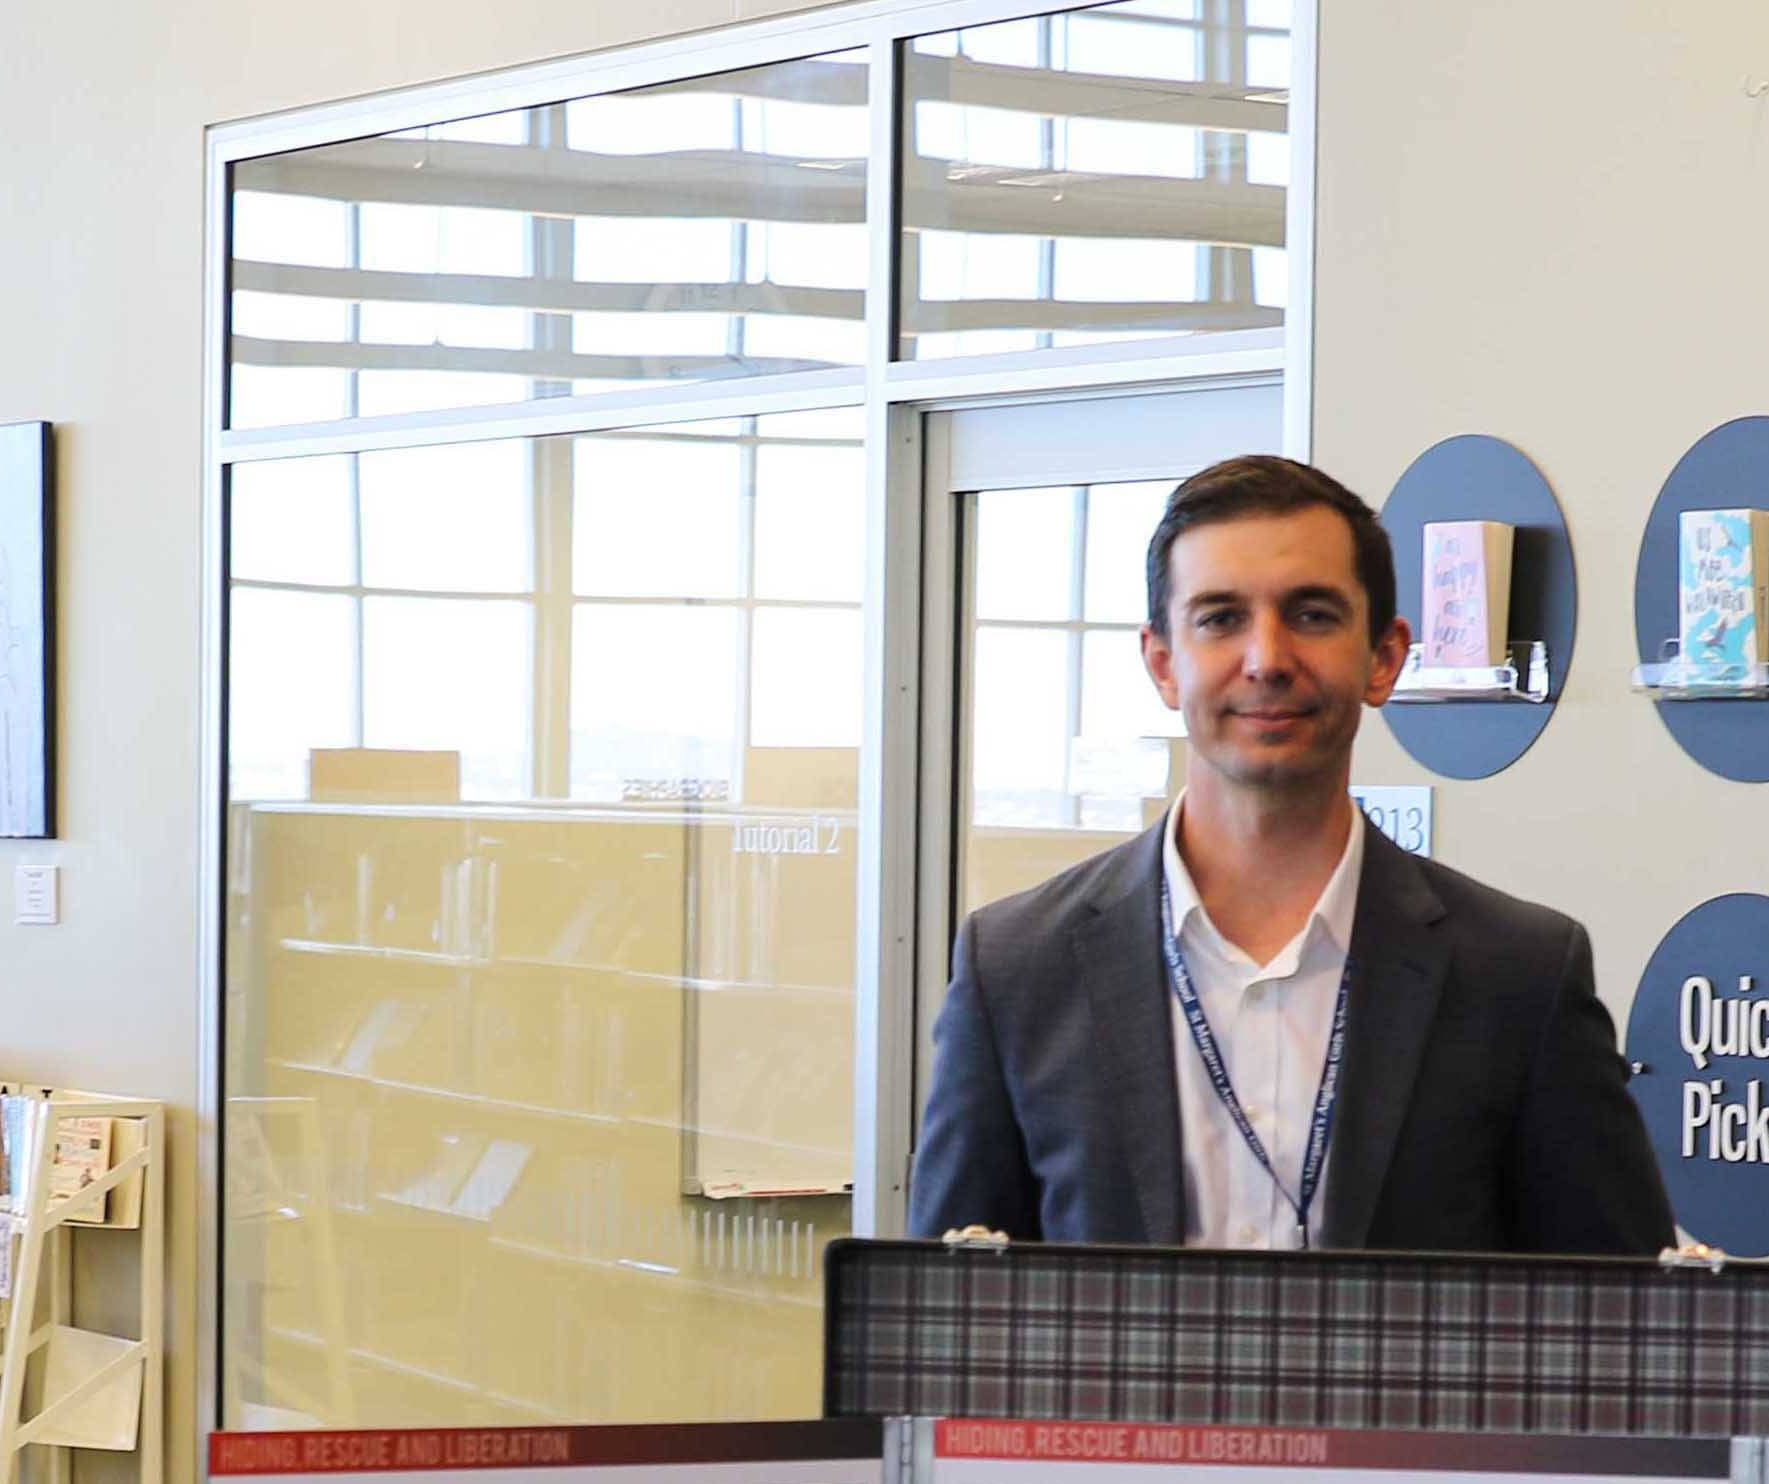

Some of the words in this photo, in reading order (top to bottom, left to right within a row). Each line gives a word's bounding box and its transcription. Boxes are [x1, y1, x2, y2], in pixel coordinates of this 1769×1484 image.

[733, 816, 820, 855] Tutorial
[823, 817, 841, 855] 2
[1192, 1021, 1229, 1087] Margaret's
[303, 1437, 389, 1467] RESCUE
[395, 1434, 442, 1465] AND
[445, 1432, 568, 1464] LIBERATION
[1034, 1426, 1128, 1457] RESCUE
[1136, 1430, 1182, 1460] AND
[1189, 1431, 1327, 1462] LIBERATION
